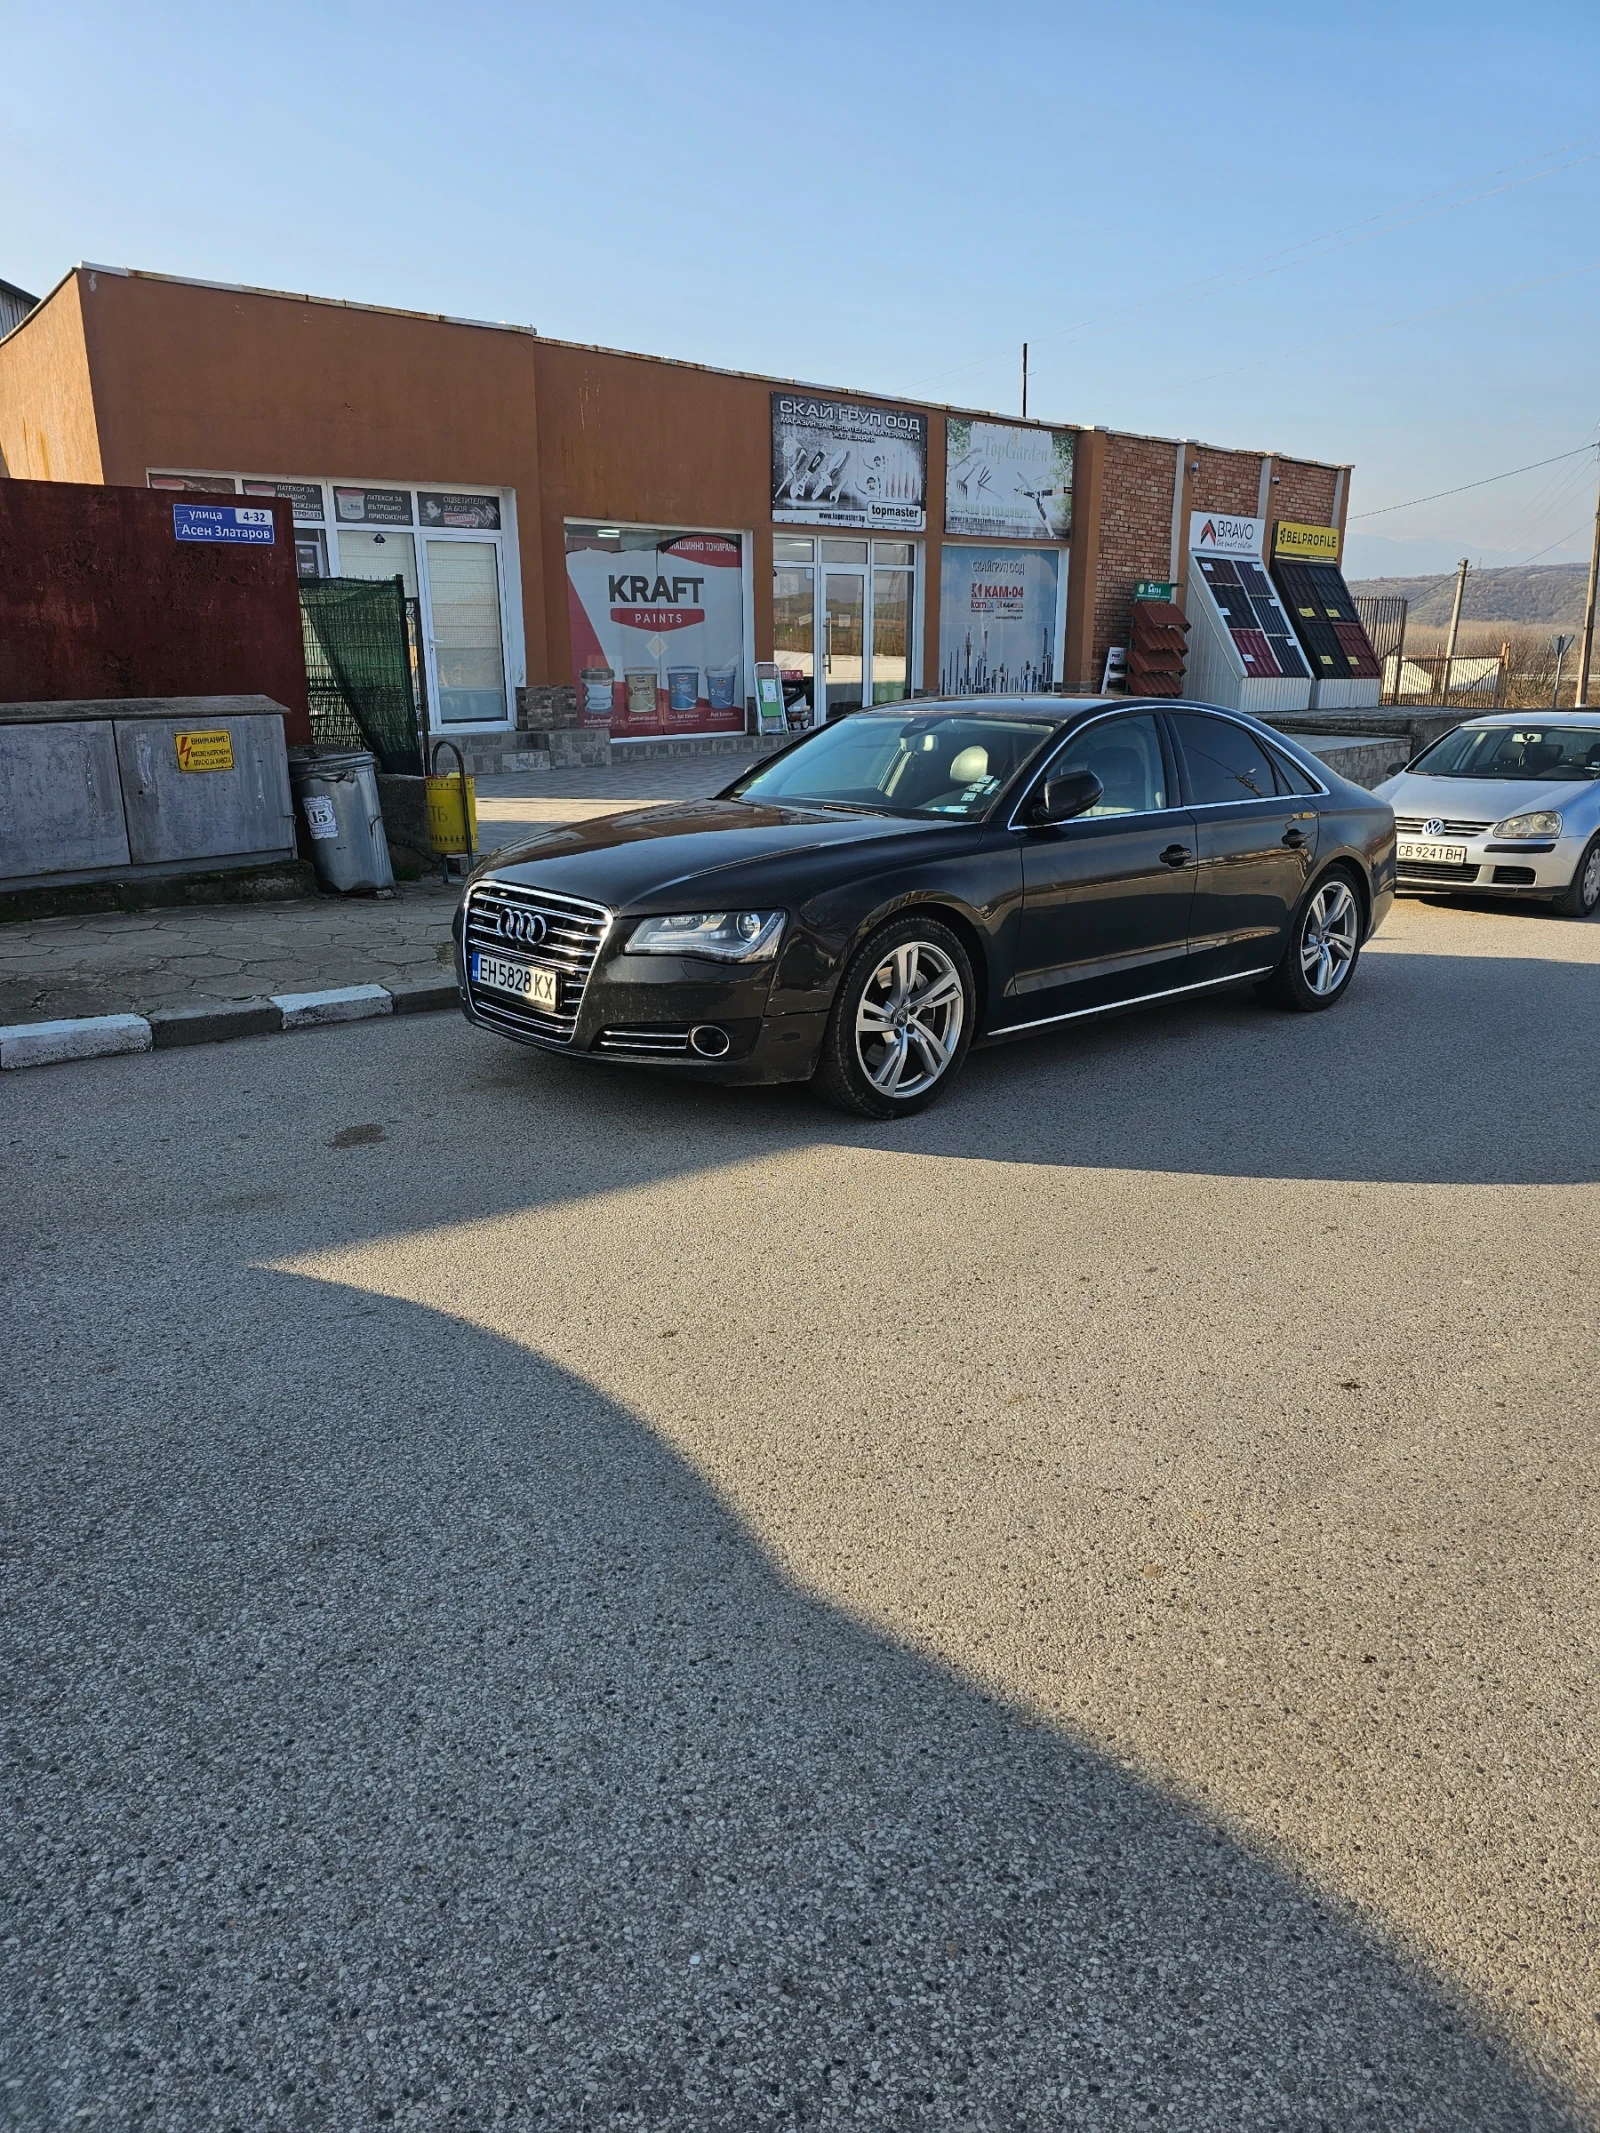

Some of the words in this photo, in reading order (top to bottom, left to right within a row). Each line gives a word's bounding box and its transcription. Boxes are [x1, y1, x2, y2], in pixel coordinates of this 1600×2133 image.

[780, 401, 833, 419] СКАЙ
[838, 409, 881, 426] ГРУП
[886, 415, 920, 432] ООД
[780, 417, 815, 427] МАГАЗИН
[983, 436, 1048, 464] TopGarden
[443, 496, 487, 505] ОЦВЕТИТЕЛИ
[367, 504, 402, 512] ВЪТРЕШНО
[872, 504, 919, 518] topmaster
[189, 510, 223, 520] улица
[243, 512, 266, 522] 4-32
[369, 513, 409, 521] ПРИЛОЖЕНИЕ
[819, 512, 866, 523] www.topmaster.bg
[182, 524, 212, 536] Асен
[215, 525, 270, 540] Златаров
[1218, 520, 1254, 540] BRAVO
[1286, 531, 1336, 548] BELPROFILE
[609, 575, 704, 603] KRAFT
[635, 613, 682, 624] PAINTS
[191, 736, 228, 745] ВНИМАНИЕ!
[312, 810, 328, 823] 15
[1415, 847, 1443, 859] 9241
